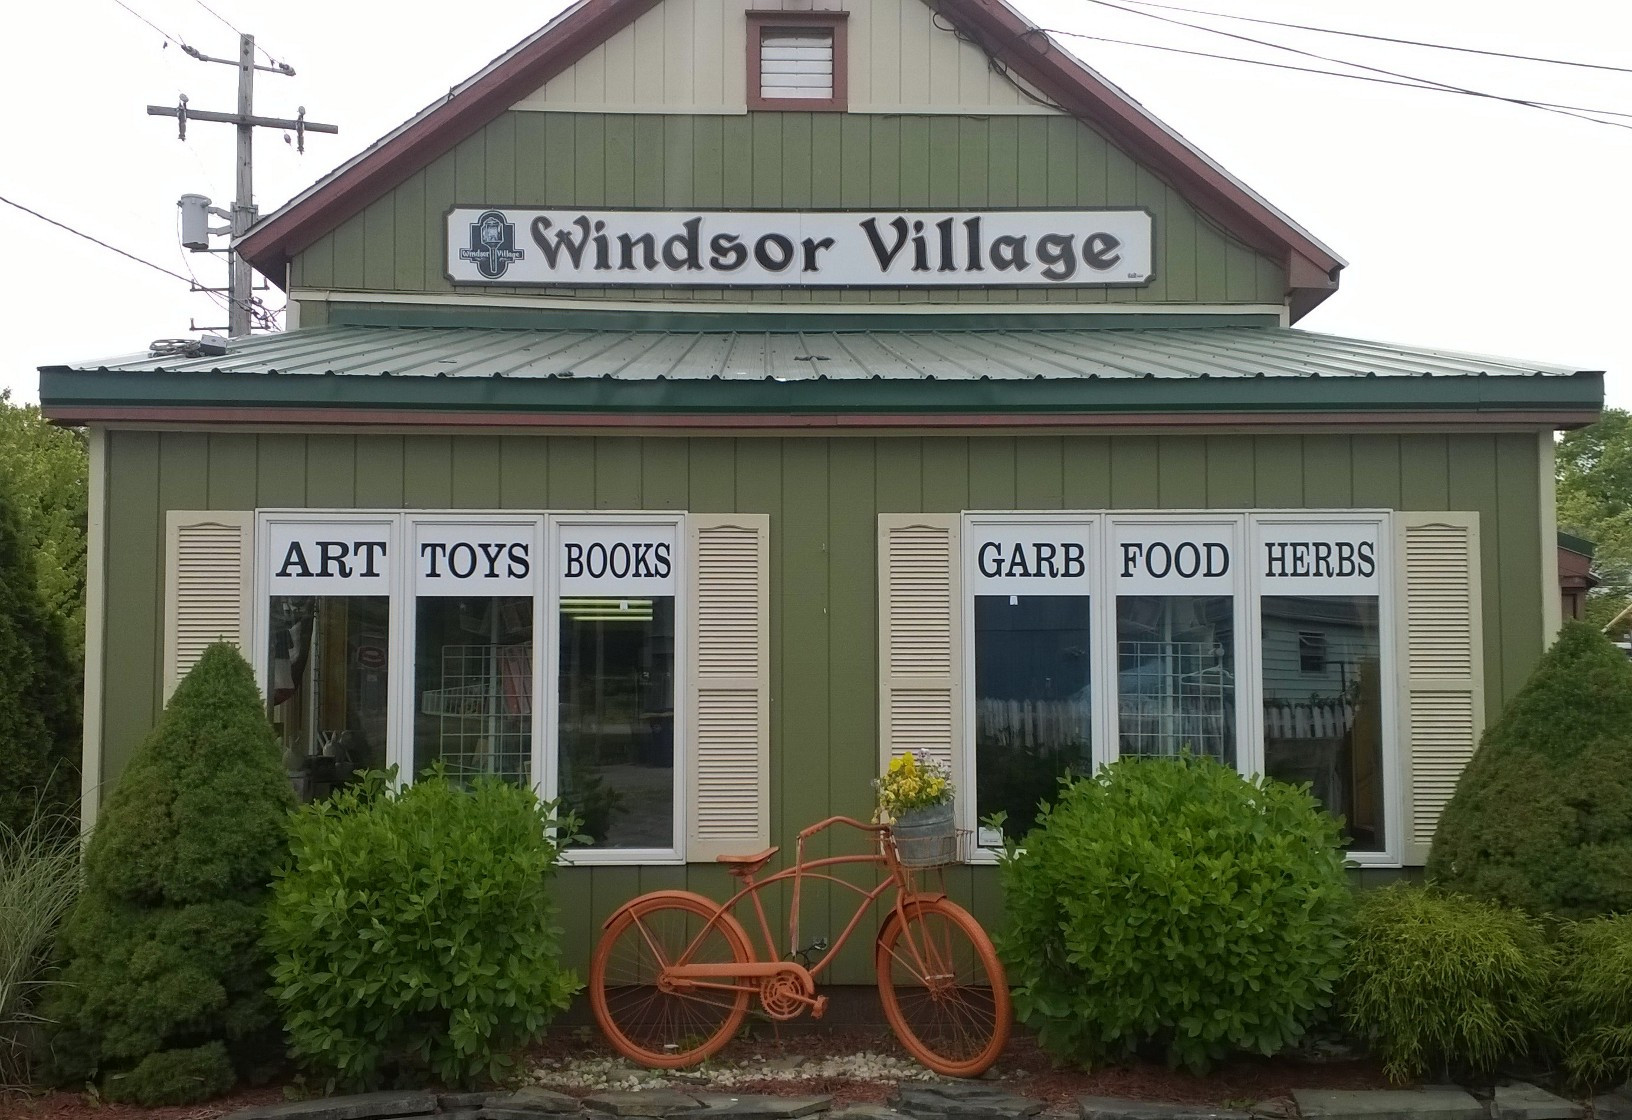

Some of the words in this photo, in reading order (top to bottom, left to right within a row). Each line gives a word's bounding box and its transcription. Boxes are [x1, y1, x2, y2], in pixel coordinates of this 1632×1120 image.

[496, 249, 520, 259] Village
[530, 215, 836, 273] Windsor
[858, 215, 1122, 282] Village
[274, 541, 387, 579] ART
[420, 542, 530, 579] TOYS
[564, 542, 672, 579] BOOKS
[977, 541, 1086, 579] GARB
[1120, 541, 1230, 579] FOOD
[1264, 540, 1376, 578] HERBS
